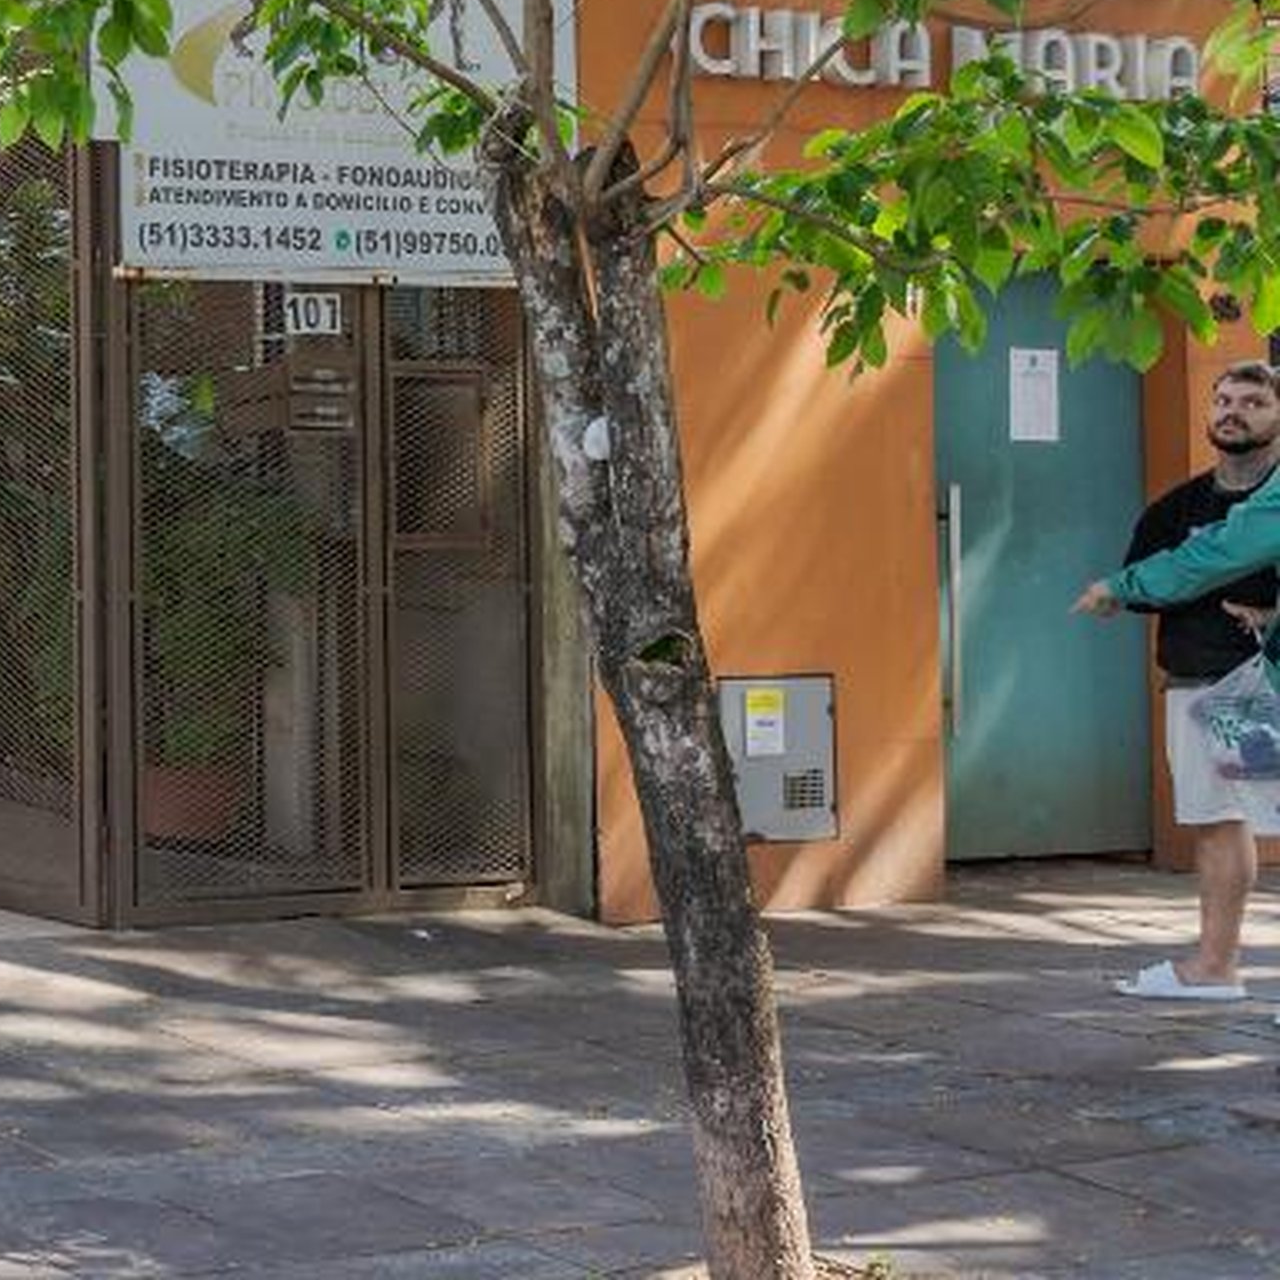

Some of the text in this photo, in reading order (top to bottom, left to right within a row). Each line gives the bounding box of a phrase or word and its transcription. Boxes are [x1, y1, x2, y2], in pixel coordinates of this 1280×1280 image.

[148, 156, 316, 184] FISIOTERAPIA
[337, 165, 482, 191] FONOAUDIO
[148, 186, 488, 216] ATENDIMENTO A DOMICILIO E CONV
[138, 222, 501, 259] (51)3333.1452 (51)99750.0
